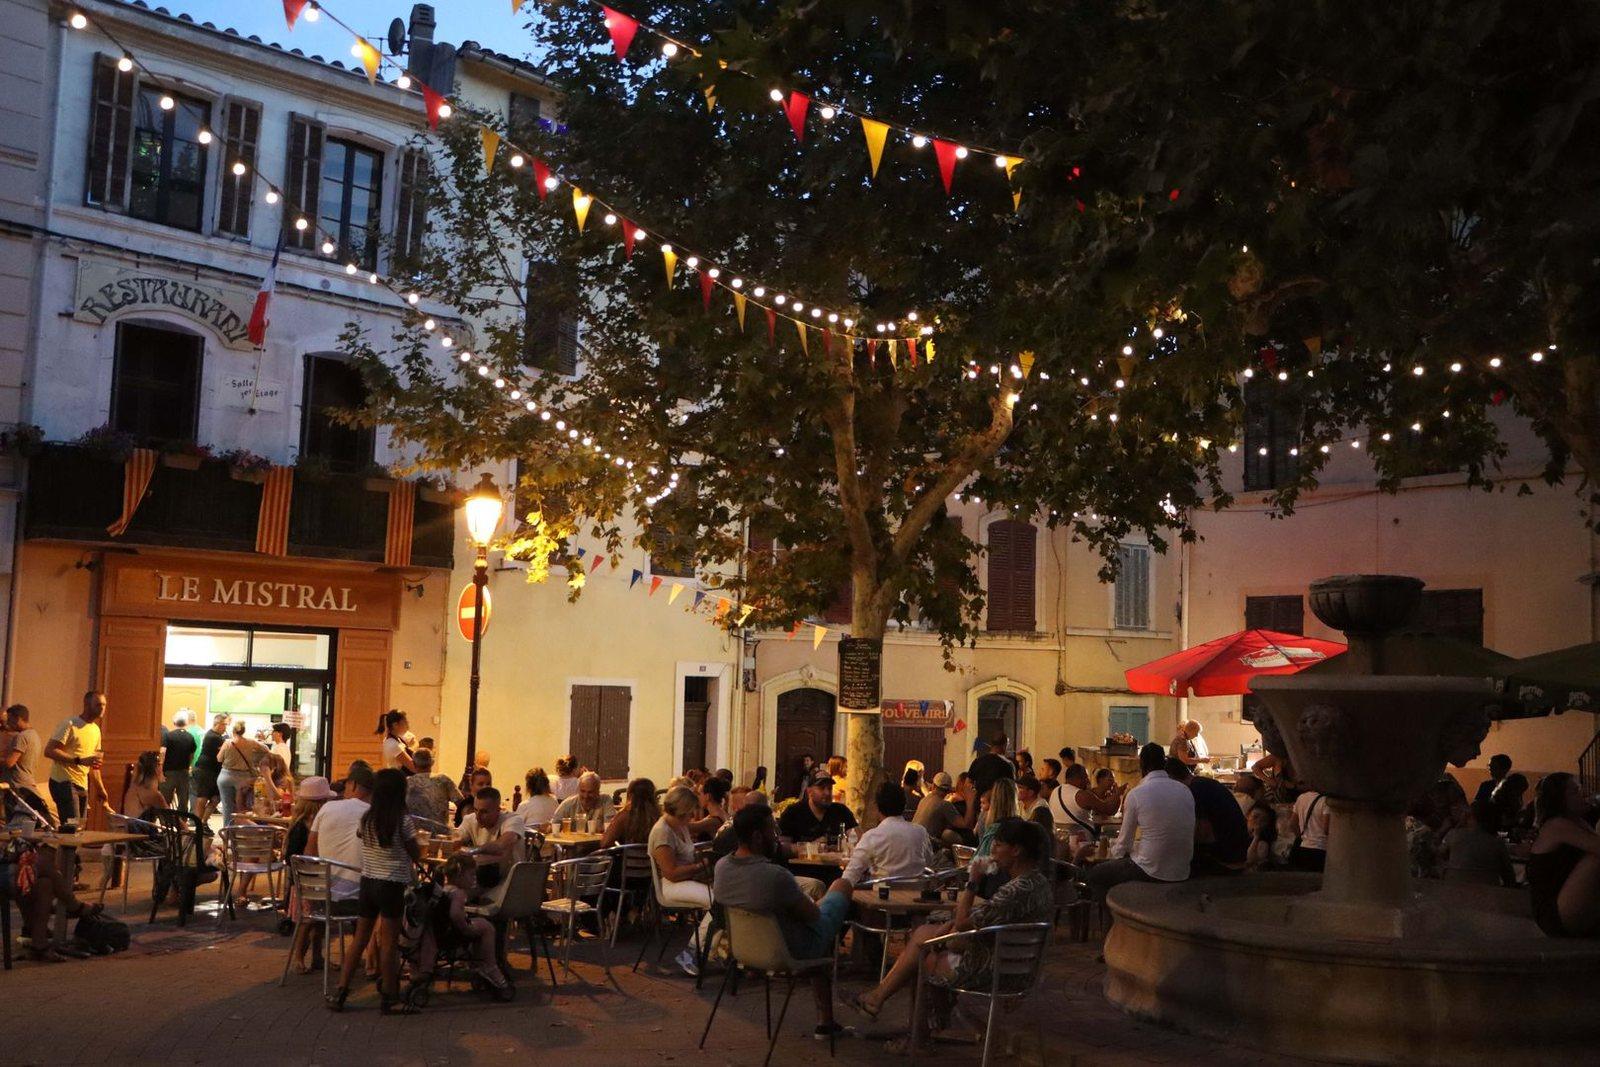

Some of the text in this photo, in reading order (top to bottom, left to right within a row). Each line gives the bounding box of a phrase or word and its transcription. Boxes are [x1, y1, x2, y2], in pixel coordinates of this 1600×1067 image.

[80, 278, 249, 343] RESTAURANT
[157, 574, 358, 612] LE MISTRAL
